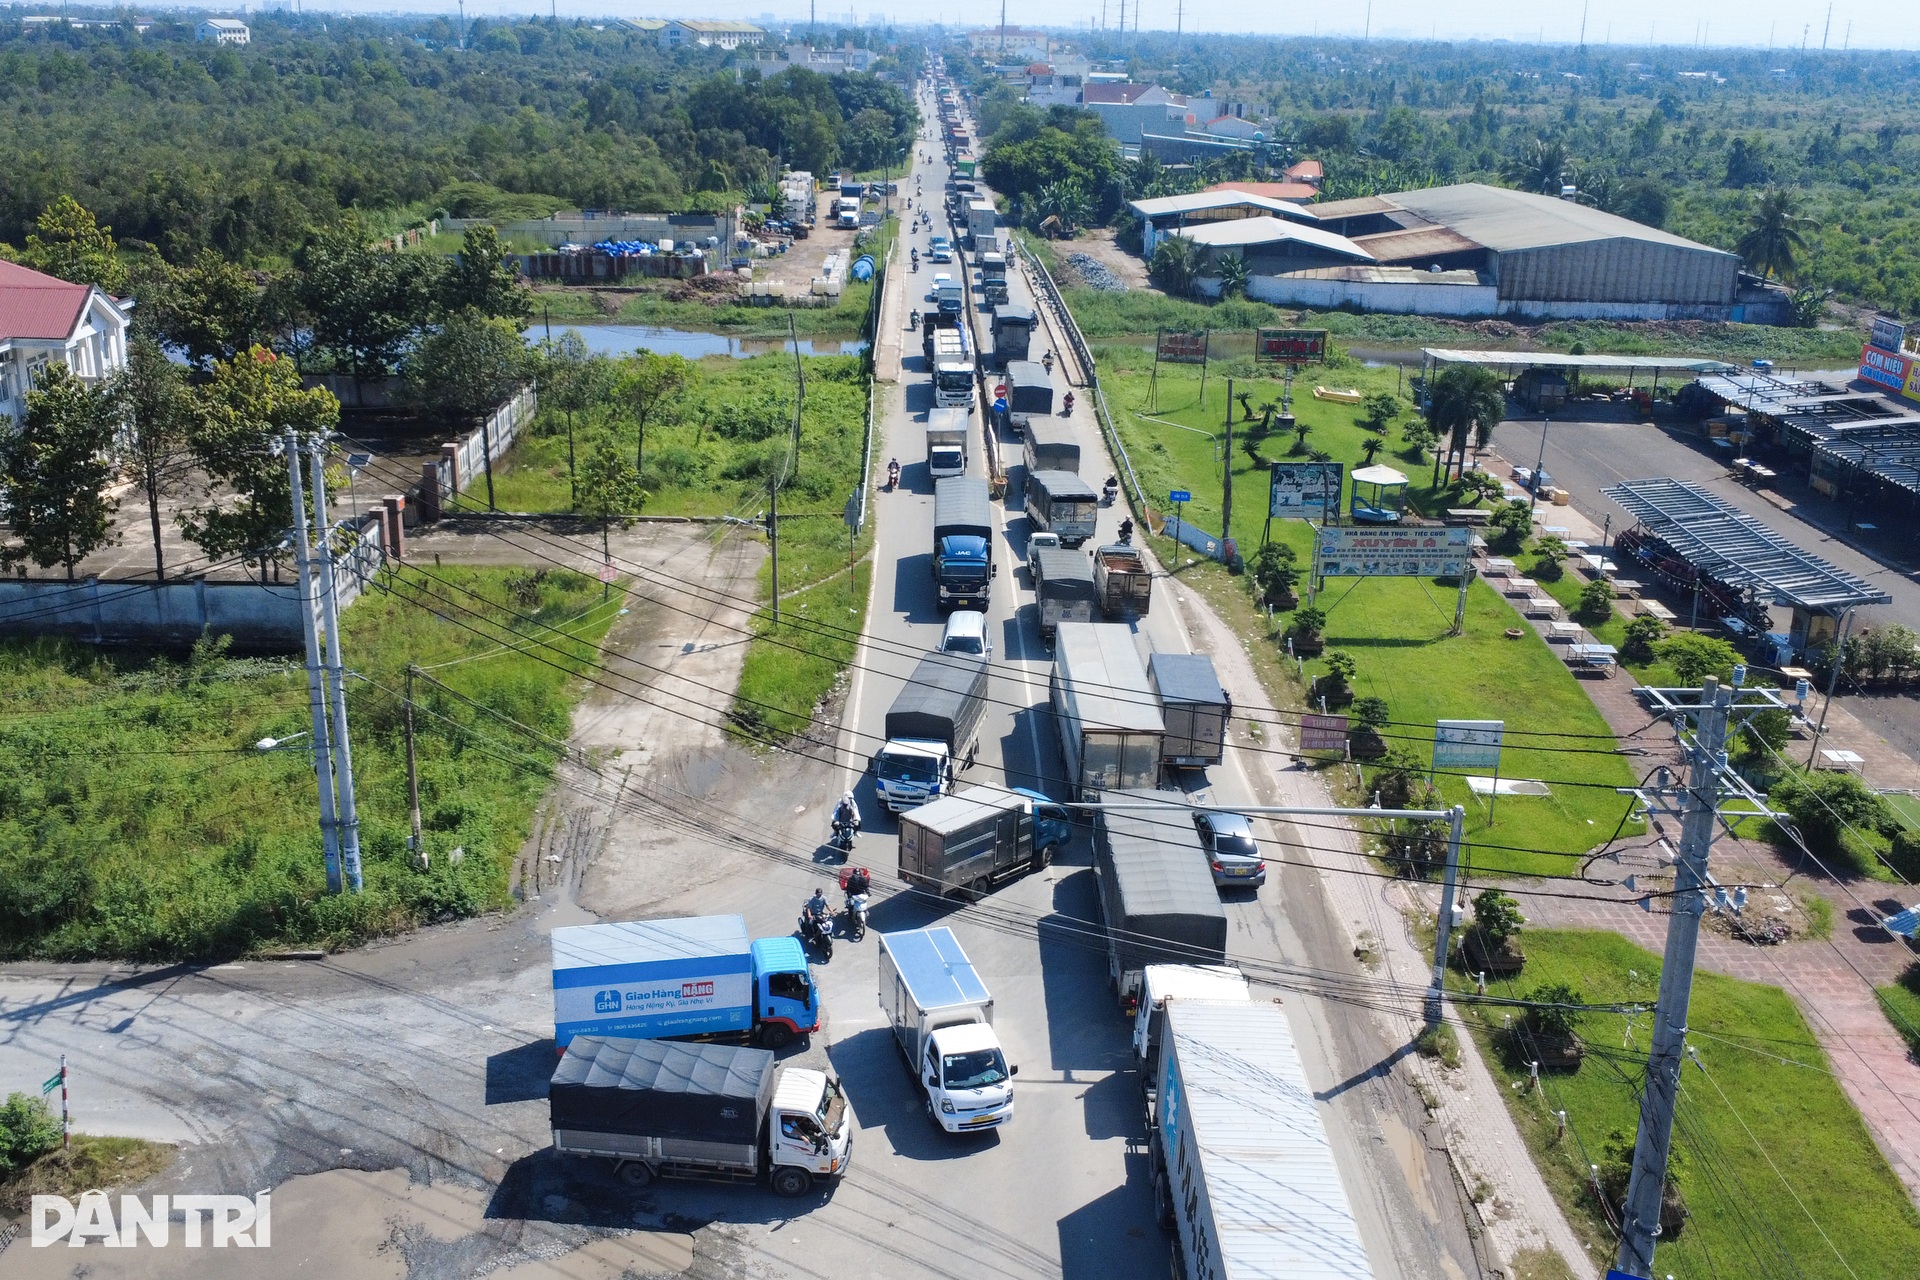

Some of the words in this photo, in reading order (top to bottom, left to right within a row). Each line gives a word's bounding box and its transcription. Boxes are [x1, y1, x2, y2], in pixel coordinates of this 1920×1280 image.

[1866, 351, 1883, 367] CƠM
[683, 983, 713, 997] NẶNG
[597, 1001, 619, 1010] GHN
